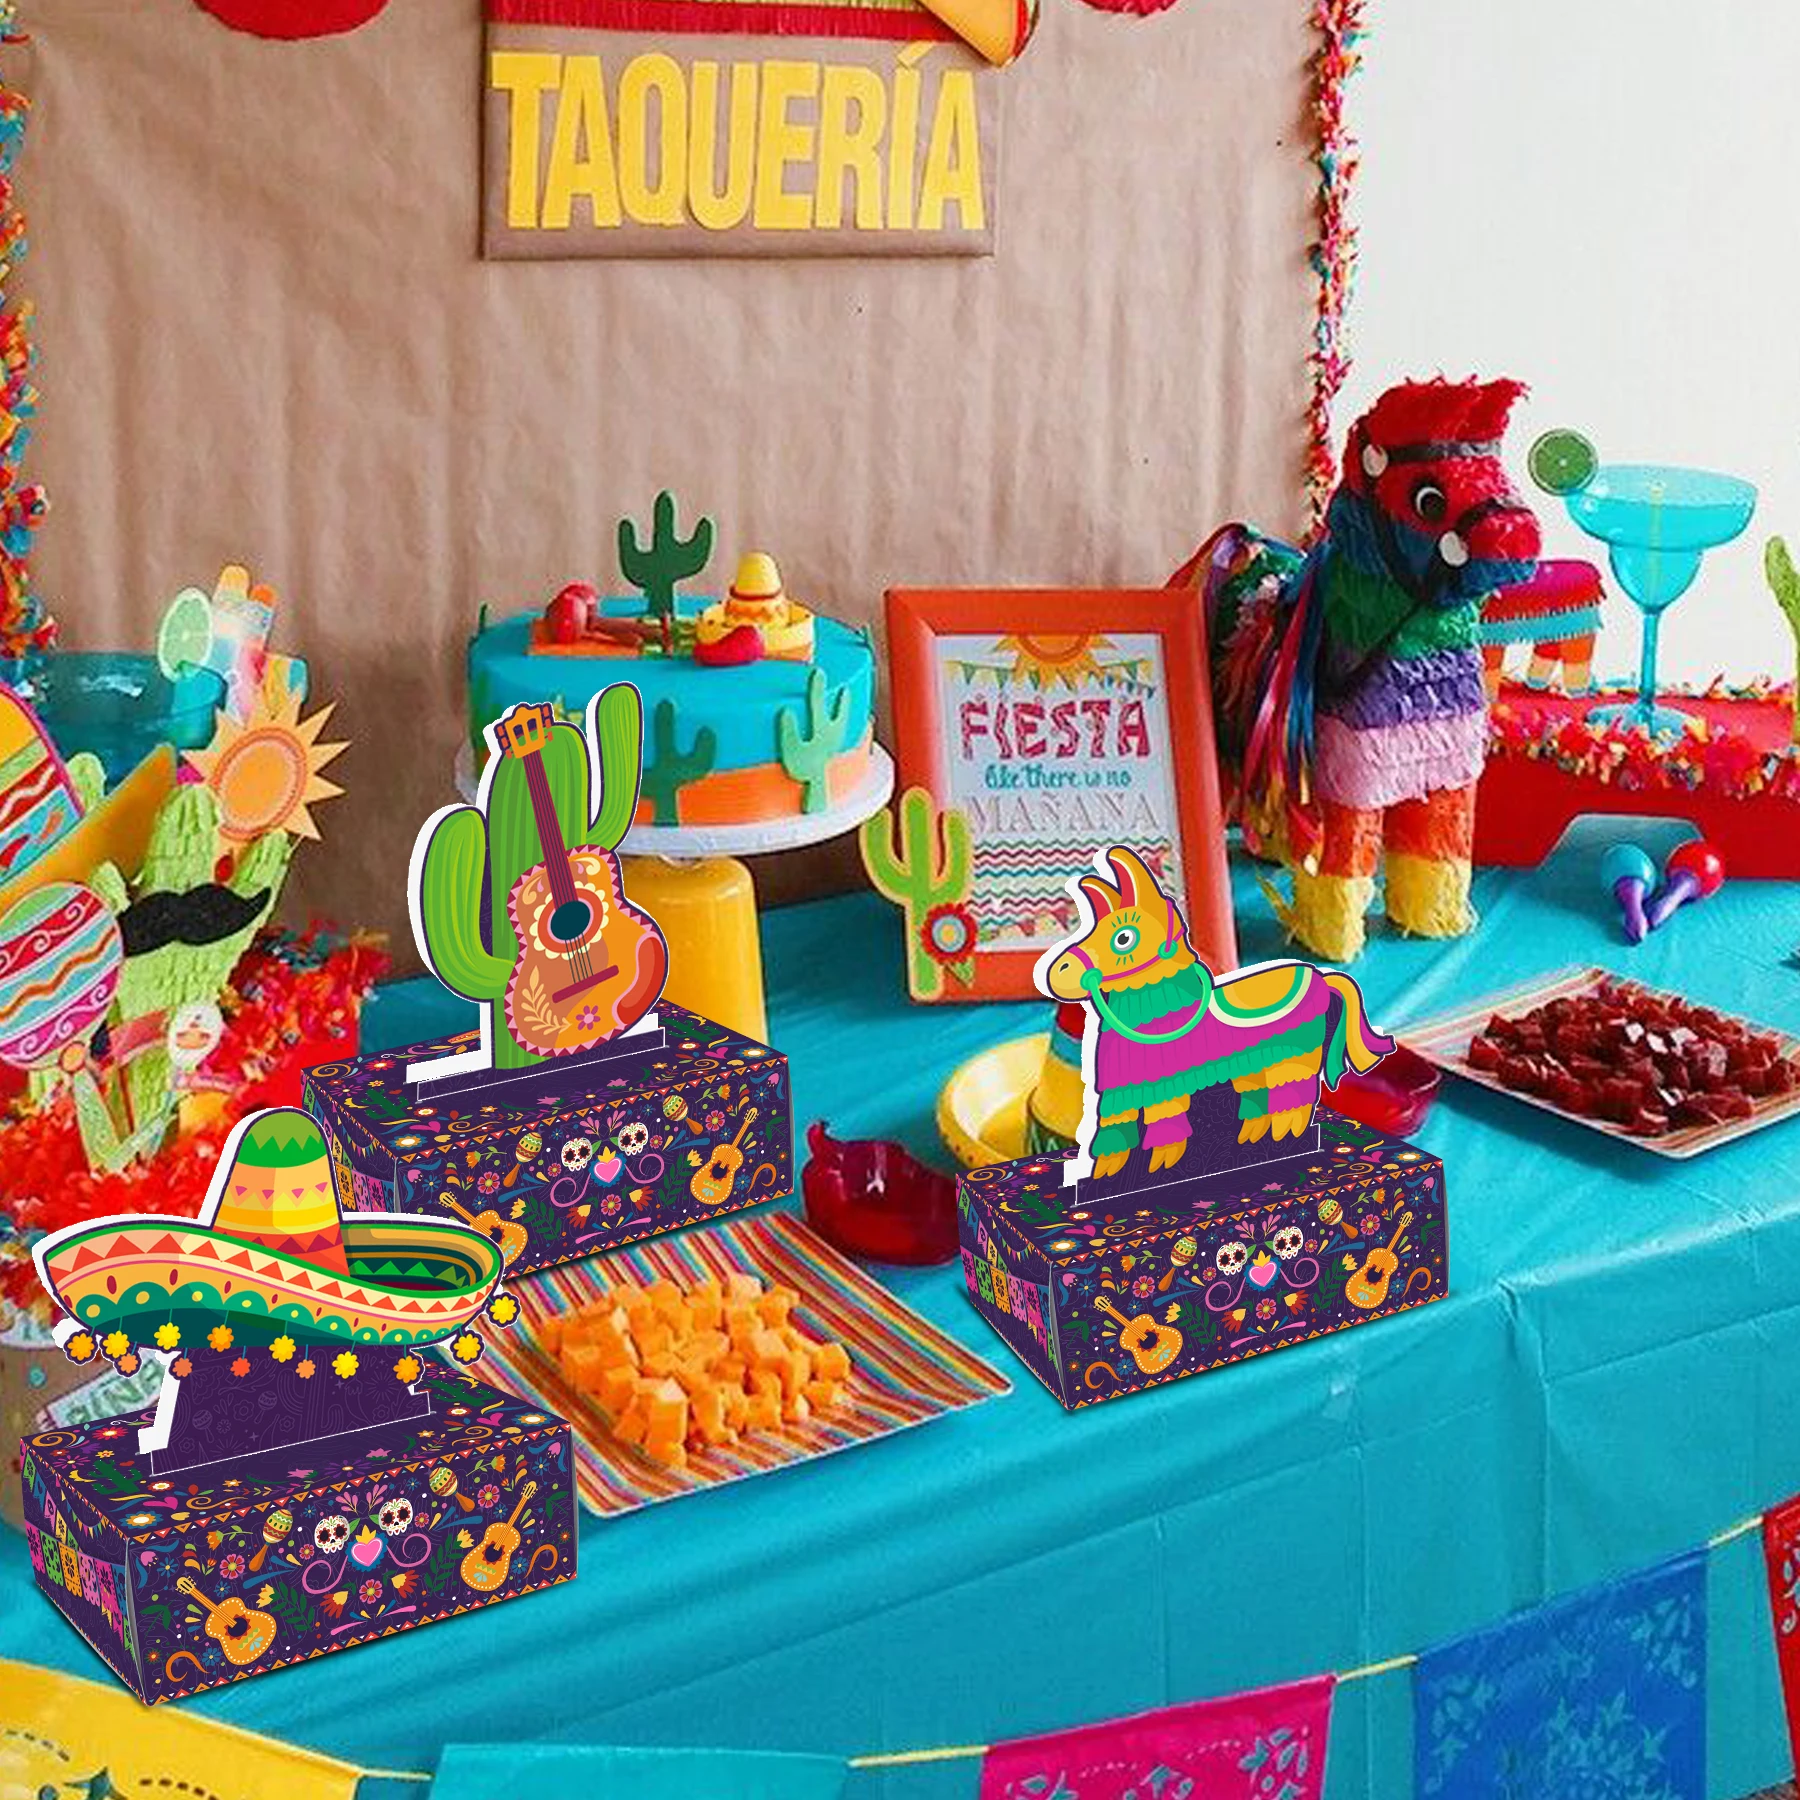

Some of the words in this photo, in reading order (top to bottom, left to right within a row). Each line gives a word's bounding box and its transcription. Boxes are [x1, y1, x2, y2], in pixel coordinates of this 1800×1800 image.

[490, 40, 986, 230] TAQUERÍA
[960, 700, 1150, 759] FIESTA
[985, 763, 1020, 789] like
[1022, 762, 1078, 788] there
[1106, 769, 1131, 787] no
